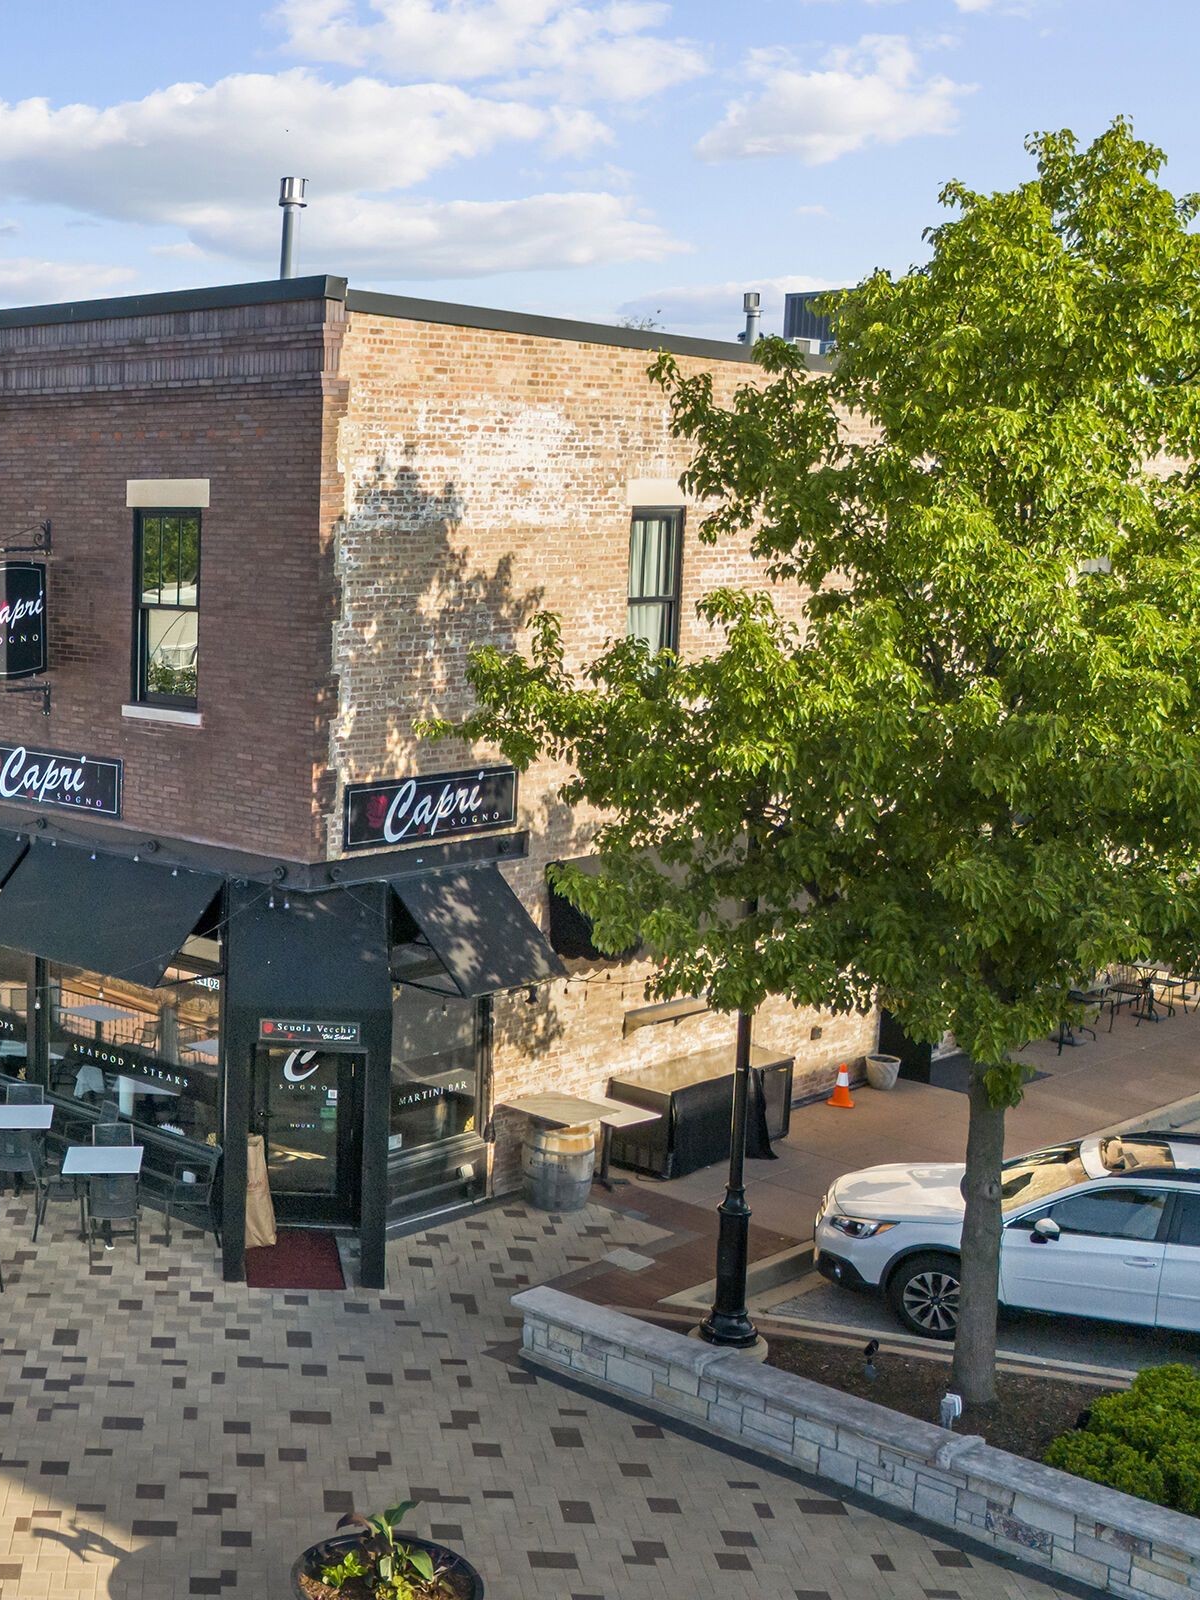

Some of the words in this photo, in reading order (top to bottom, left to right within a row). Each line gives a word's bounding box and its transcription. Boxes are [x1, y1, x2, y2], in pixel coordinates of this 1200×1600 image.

[0, 746, 87, 802] Capri
[56, 792, 102, 807] SOGNO
[383, 771, 485, 843] Capri
[451, 811, 499, 826] SOGNO
[277, 1023, 311, 1032] Scuola
[316, 1025, 357, 1034] Vecchia
[73, 1043, 125, 1066] SEAFOOD
[143, 1066, 189, 1087] STEAKS
[398, 1086, 444, 1106] MARTINI
[448, 1080, 468, 1092] BAR
